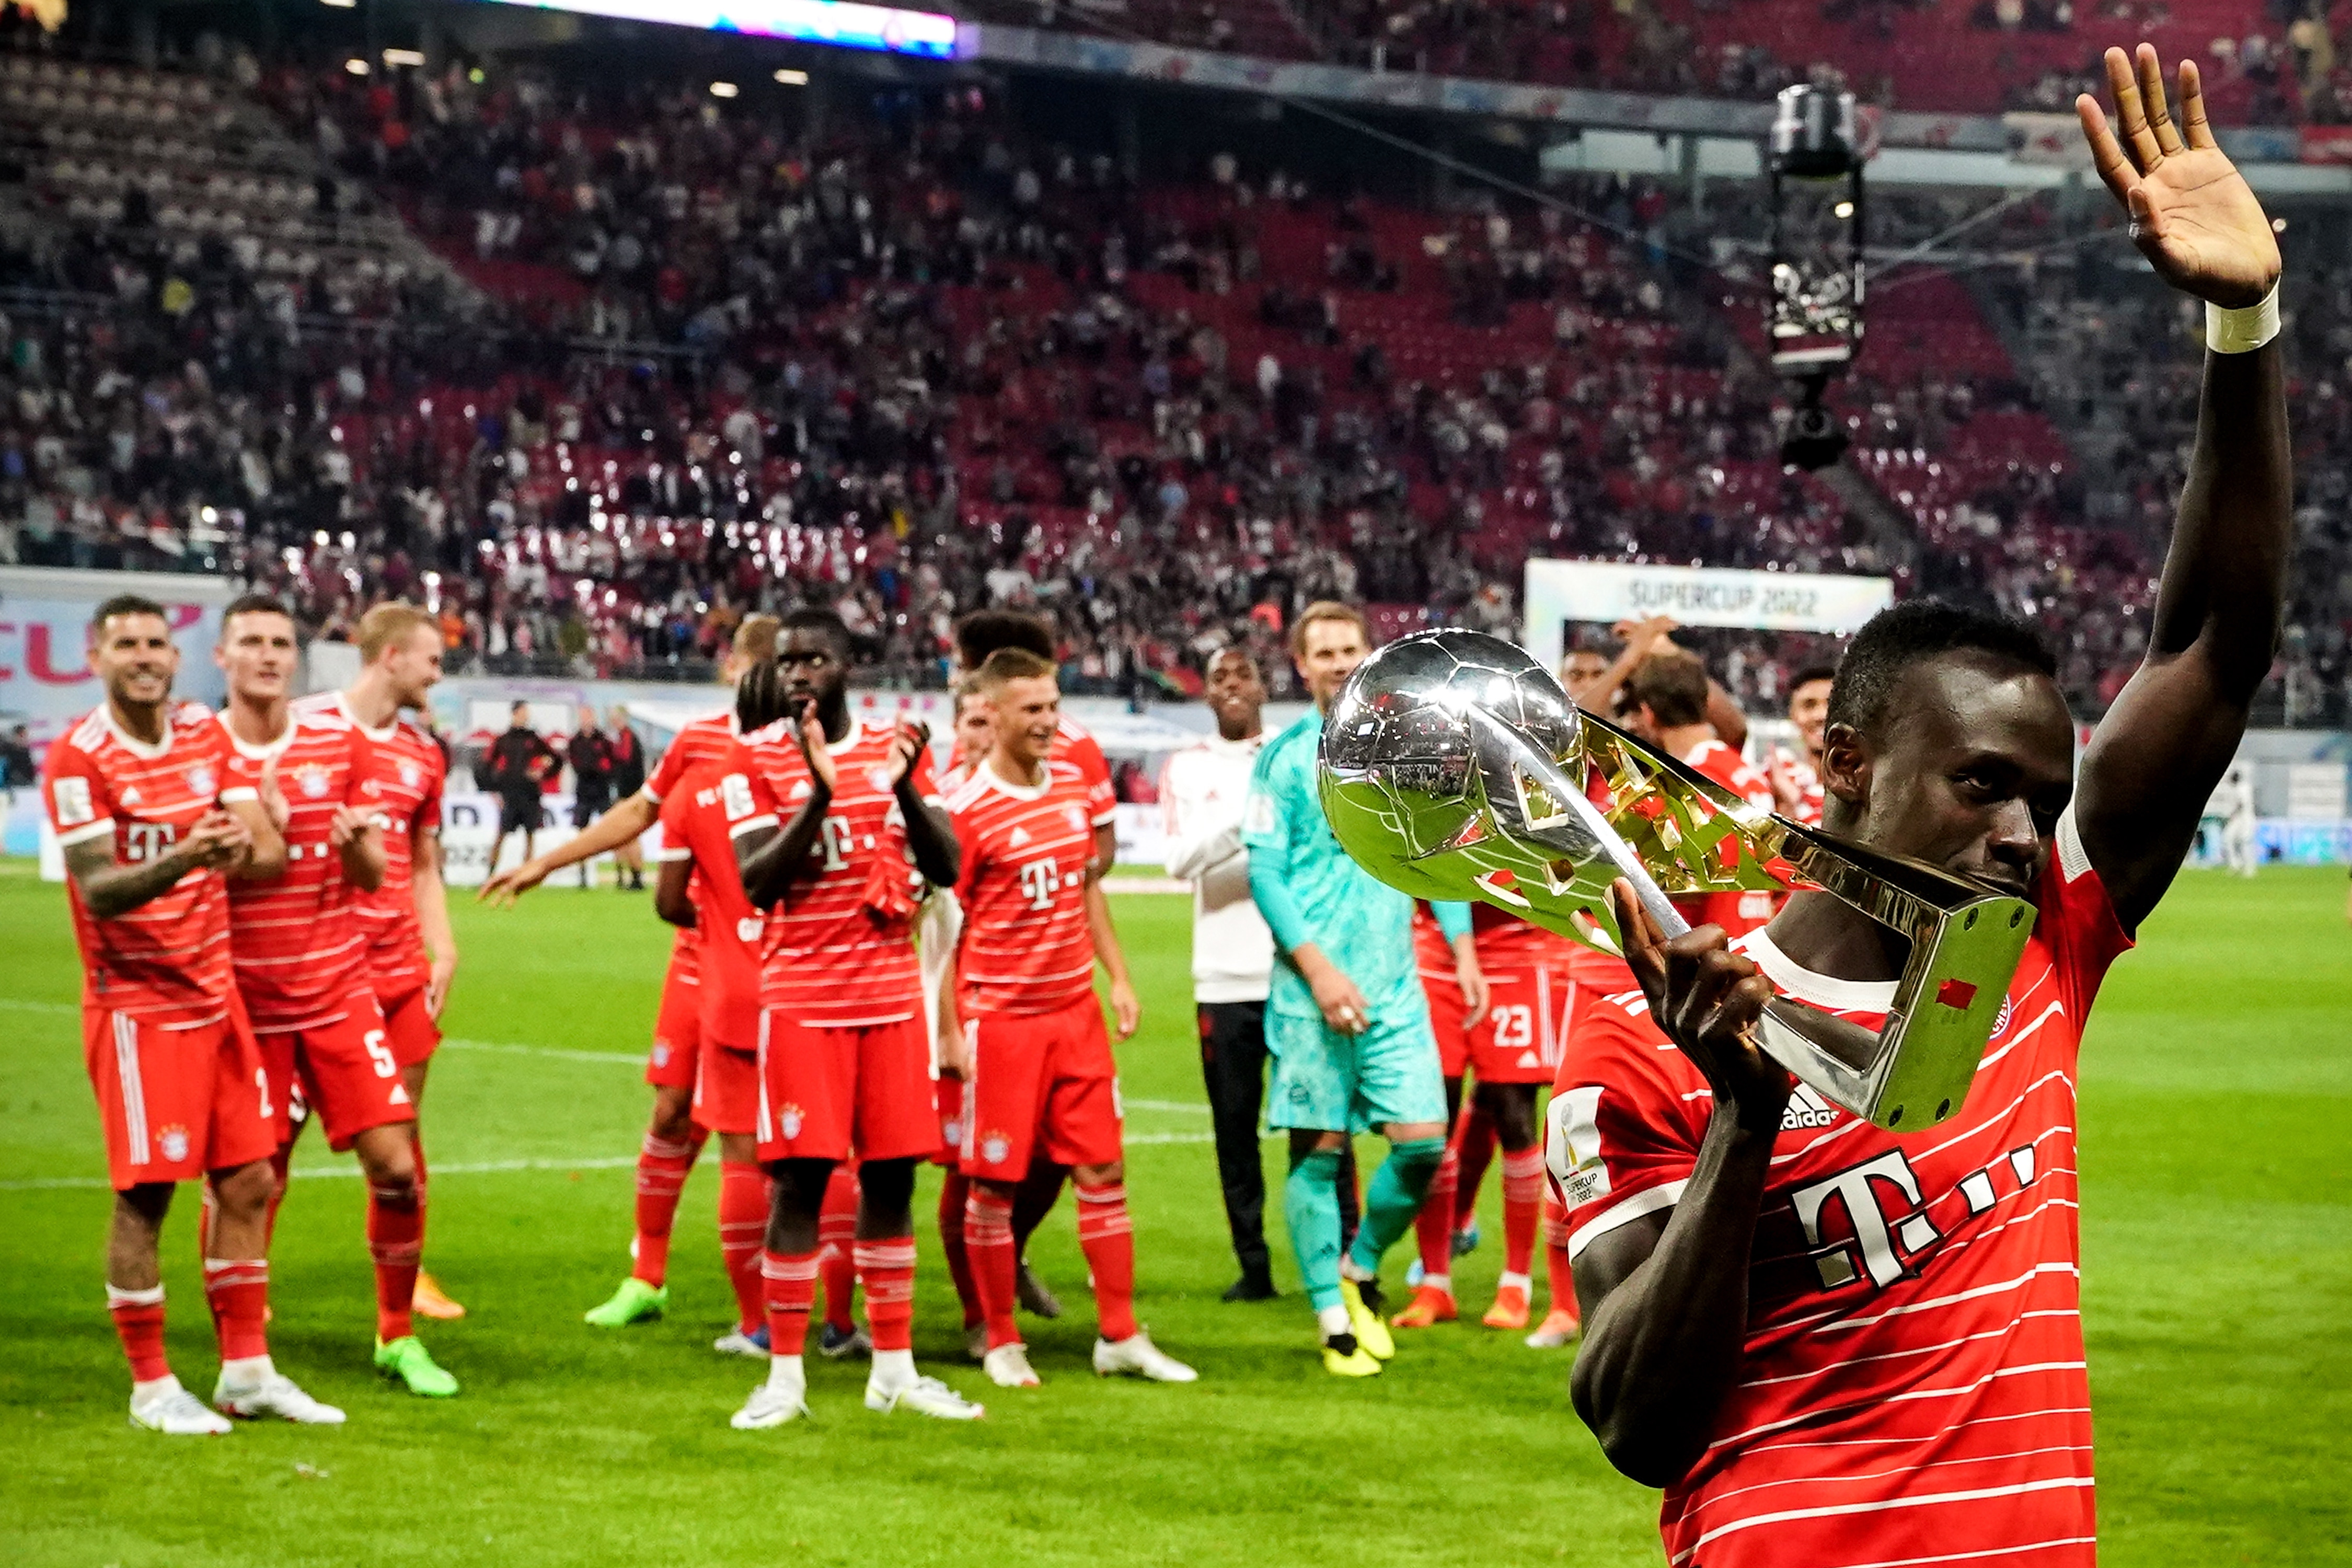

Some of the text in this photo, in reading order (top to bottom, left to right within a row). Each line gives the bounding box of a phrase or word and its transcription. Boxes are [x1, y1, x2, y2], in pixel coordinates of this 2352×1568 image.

[1629, 578, 1819, 617] SUPERCUP 2022
[1021, 856, 1059, 911] T
[1490, 1004, 1532, 1047] 23
[364, 1029, 397, 1078] 5
[1566, 1172, 1598, 1195] SUPERCUP
[1576, 1187, 1593, 1203] 2022
[1792, 1147, 1929, 1289] T
